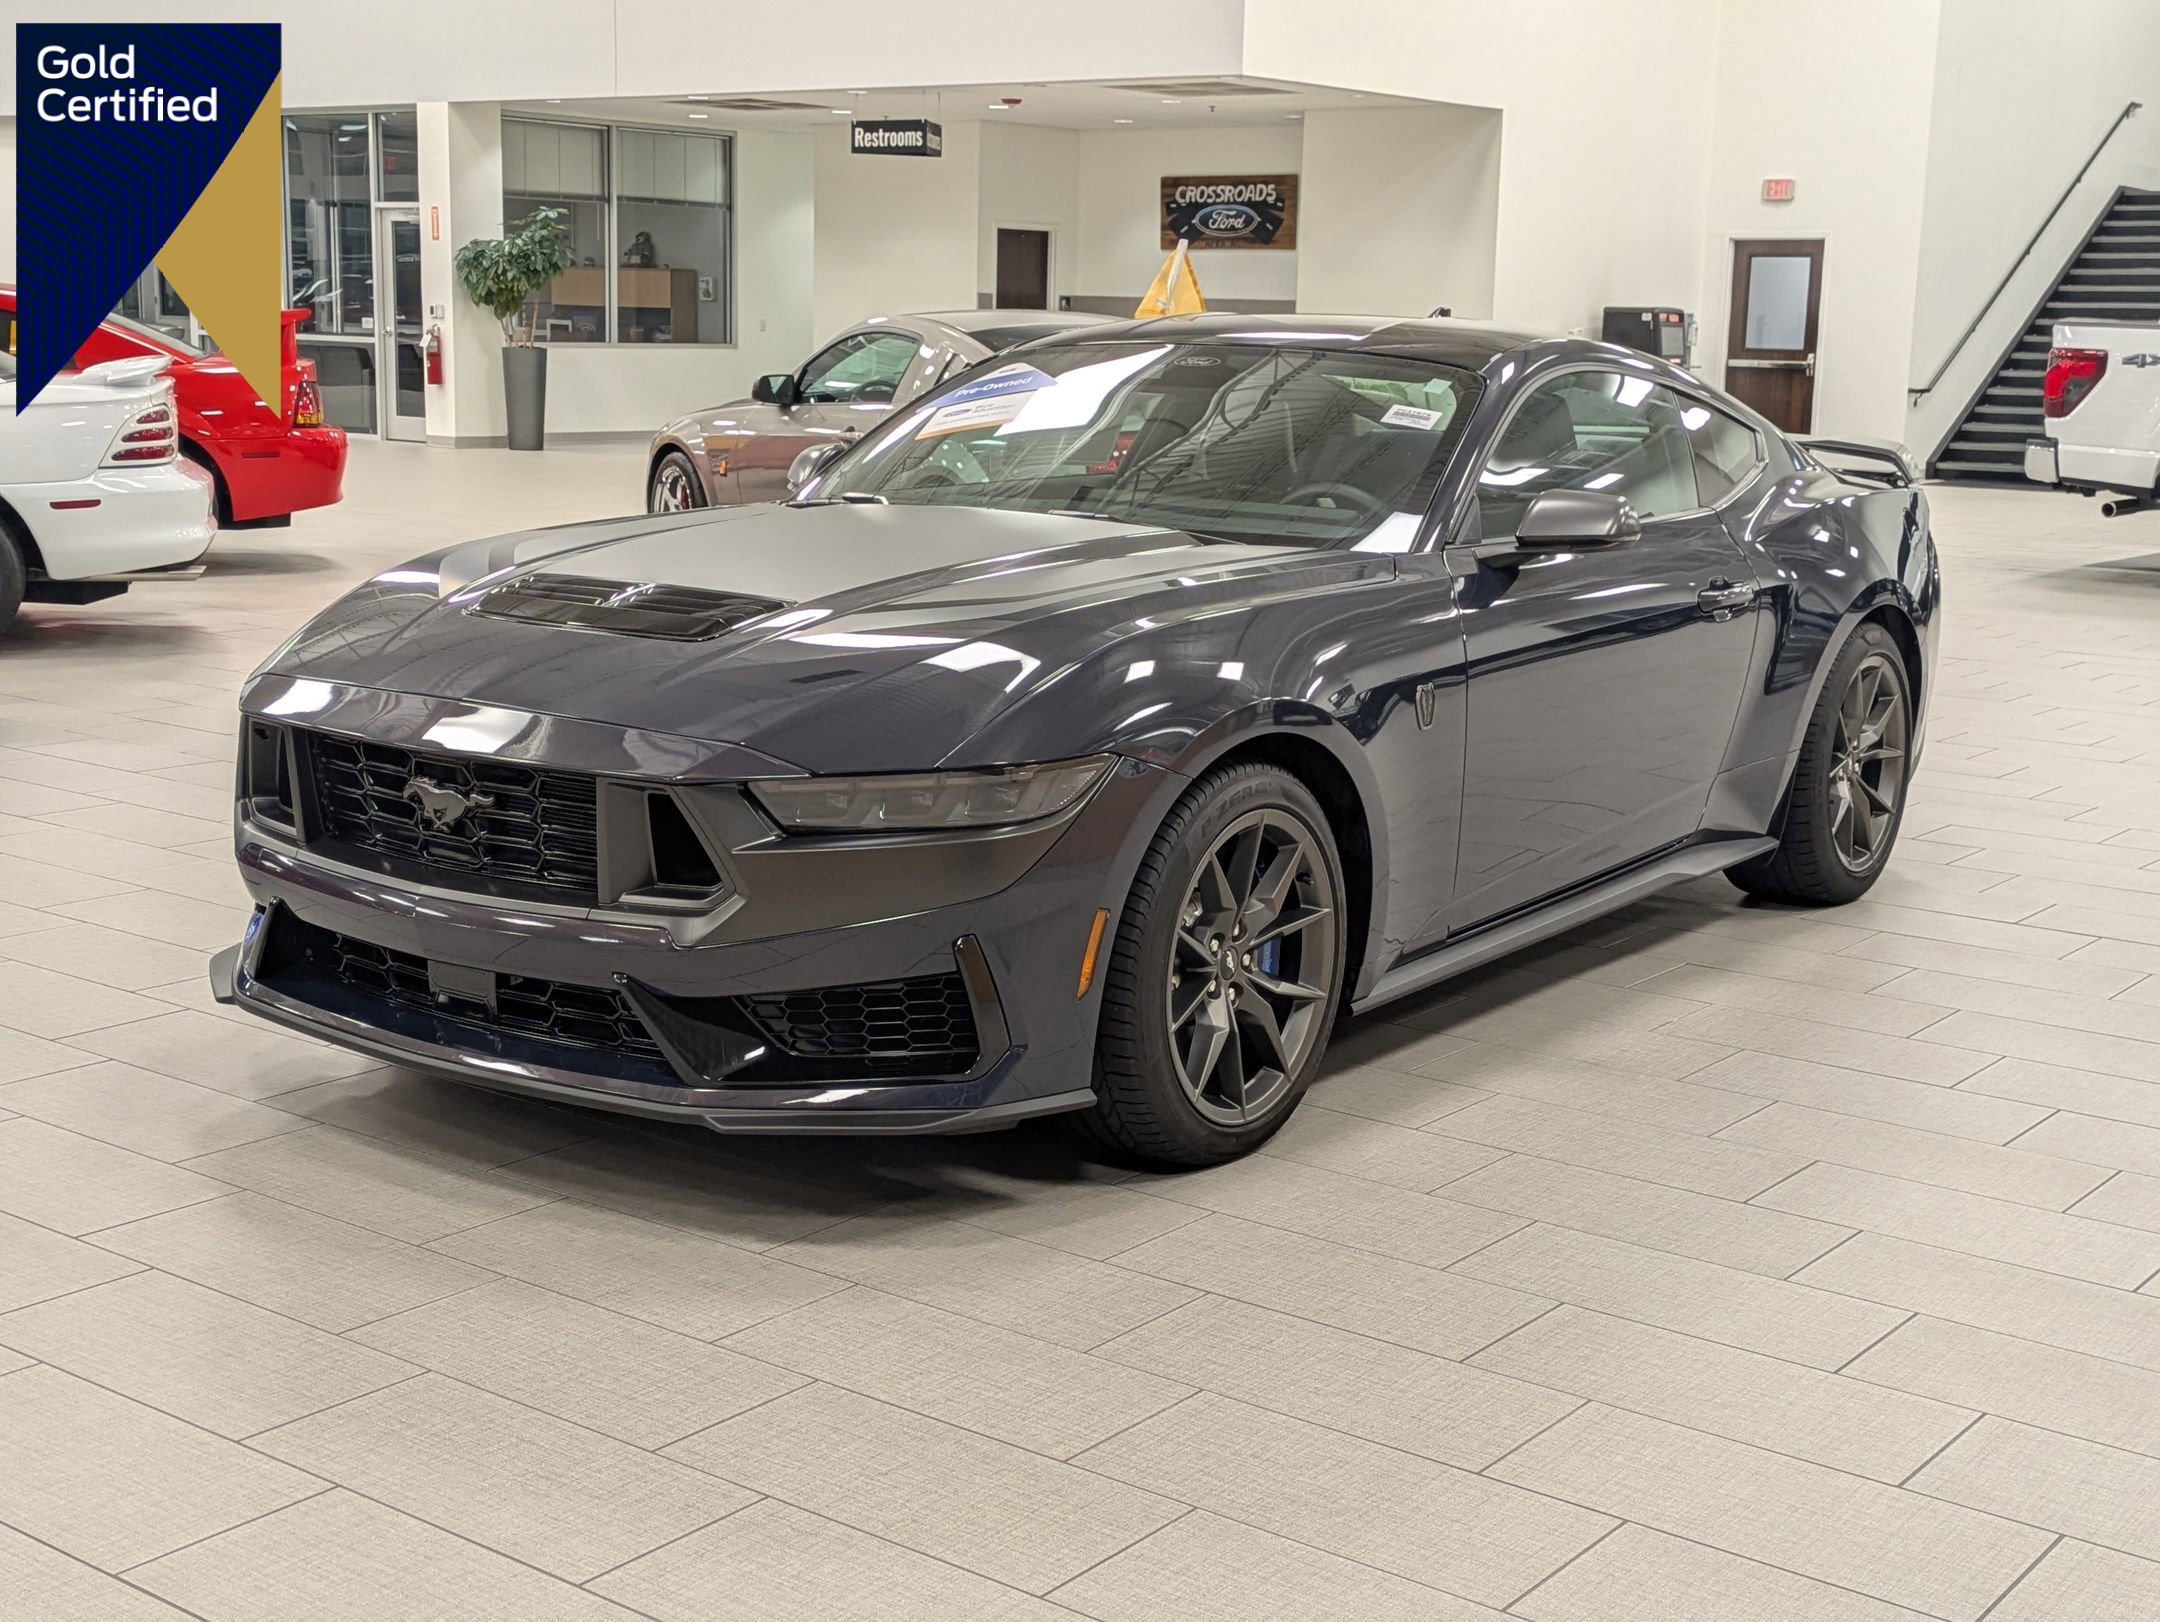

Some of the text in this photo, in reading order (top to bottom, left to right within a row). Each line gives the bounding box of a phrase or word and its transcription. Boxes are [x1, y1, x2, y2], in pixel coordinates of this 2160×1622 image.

[854, 127, 923, 148] Restrooms
[1175, 184, 1276, 204] CROSSROADS
[1208, 209, 1247, 229] Ford
[954, 377, 1032, 397] Pre-Owned
